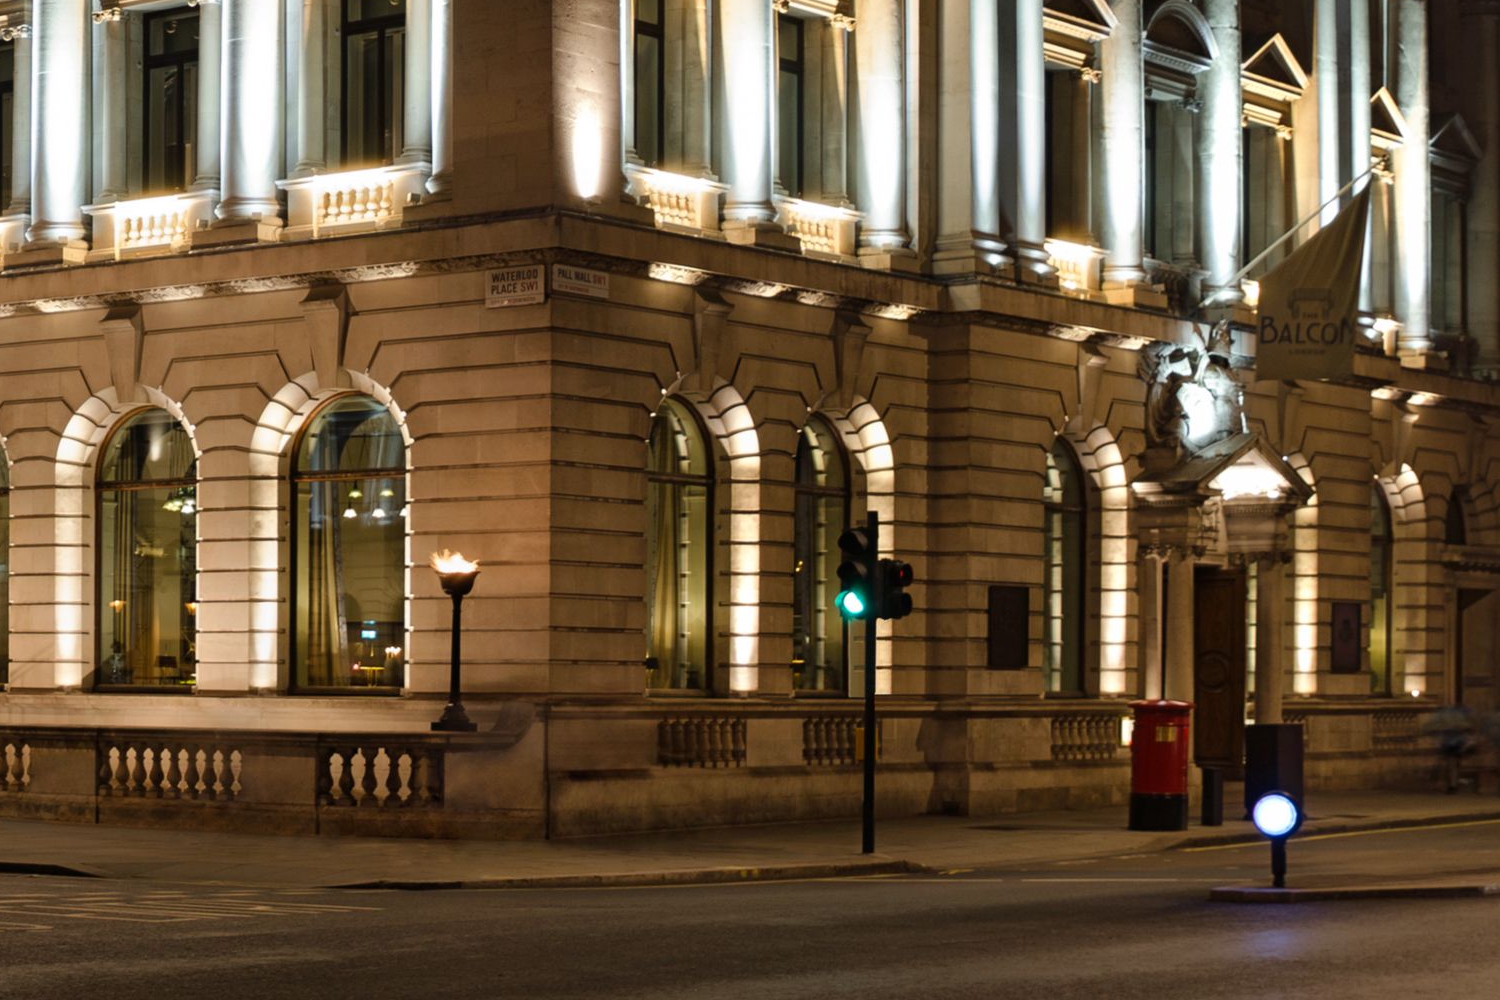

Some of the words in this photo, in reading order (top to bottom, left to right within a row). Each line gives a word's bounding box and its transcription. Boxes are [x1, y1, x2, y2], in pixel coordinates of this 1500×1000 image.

[492, 268, 538, 283] WATERLOO
[557, 267, 573, 281] PALL
[491, 282, 517, 295] PLACE
[520, 280, 539, 293] SW1
